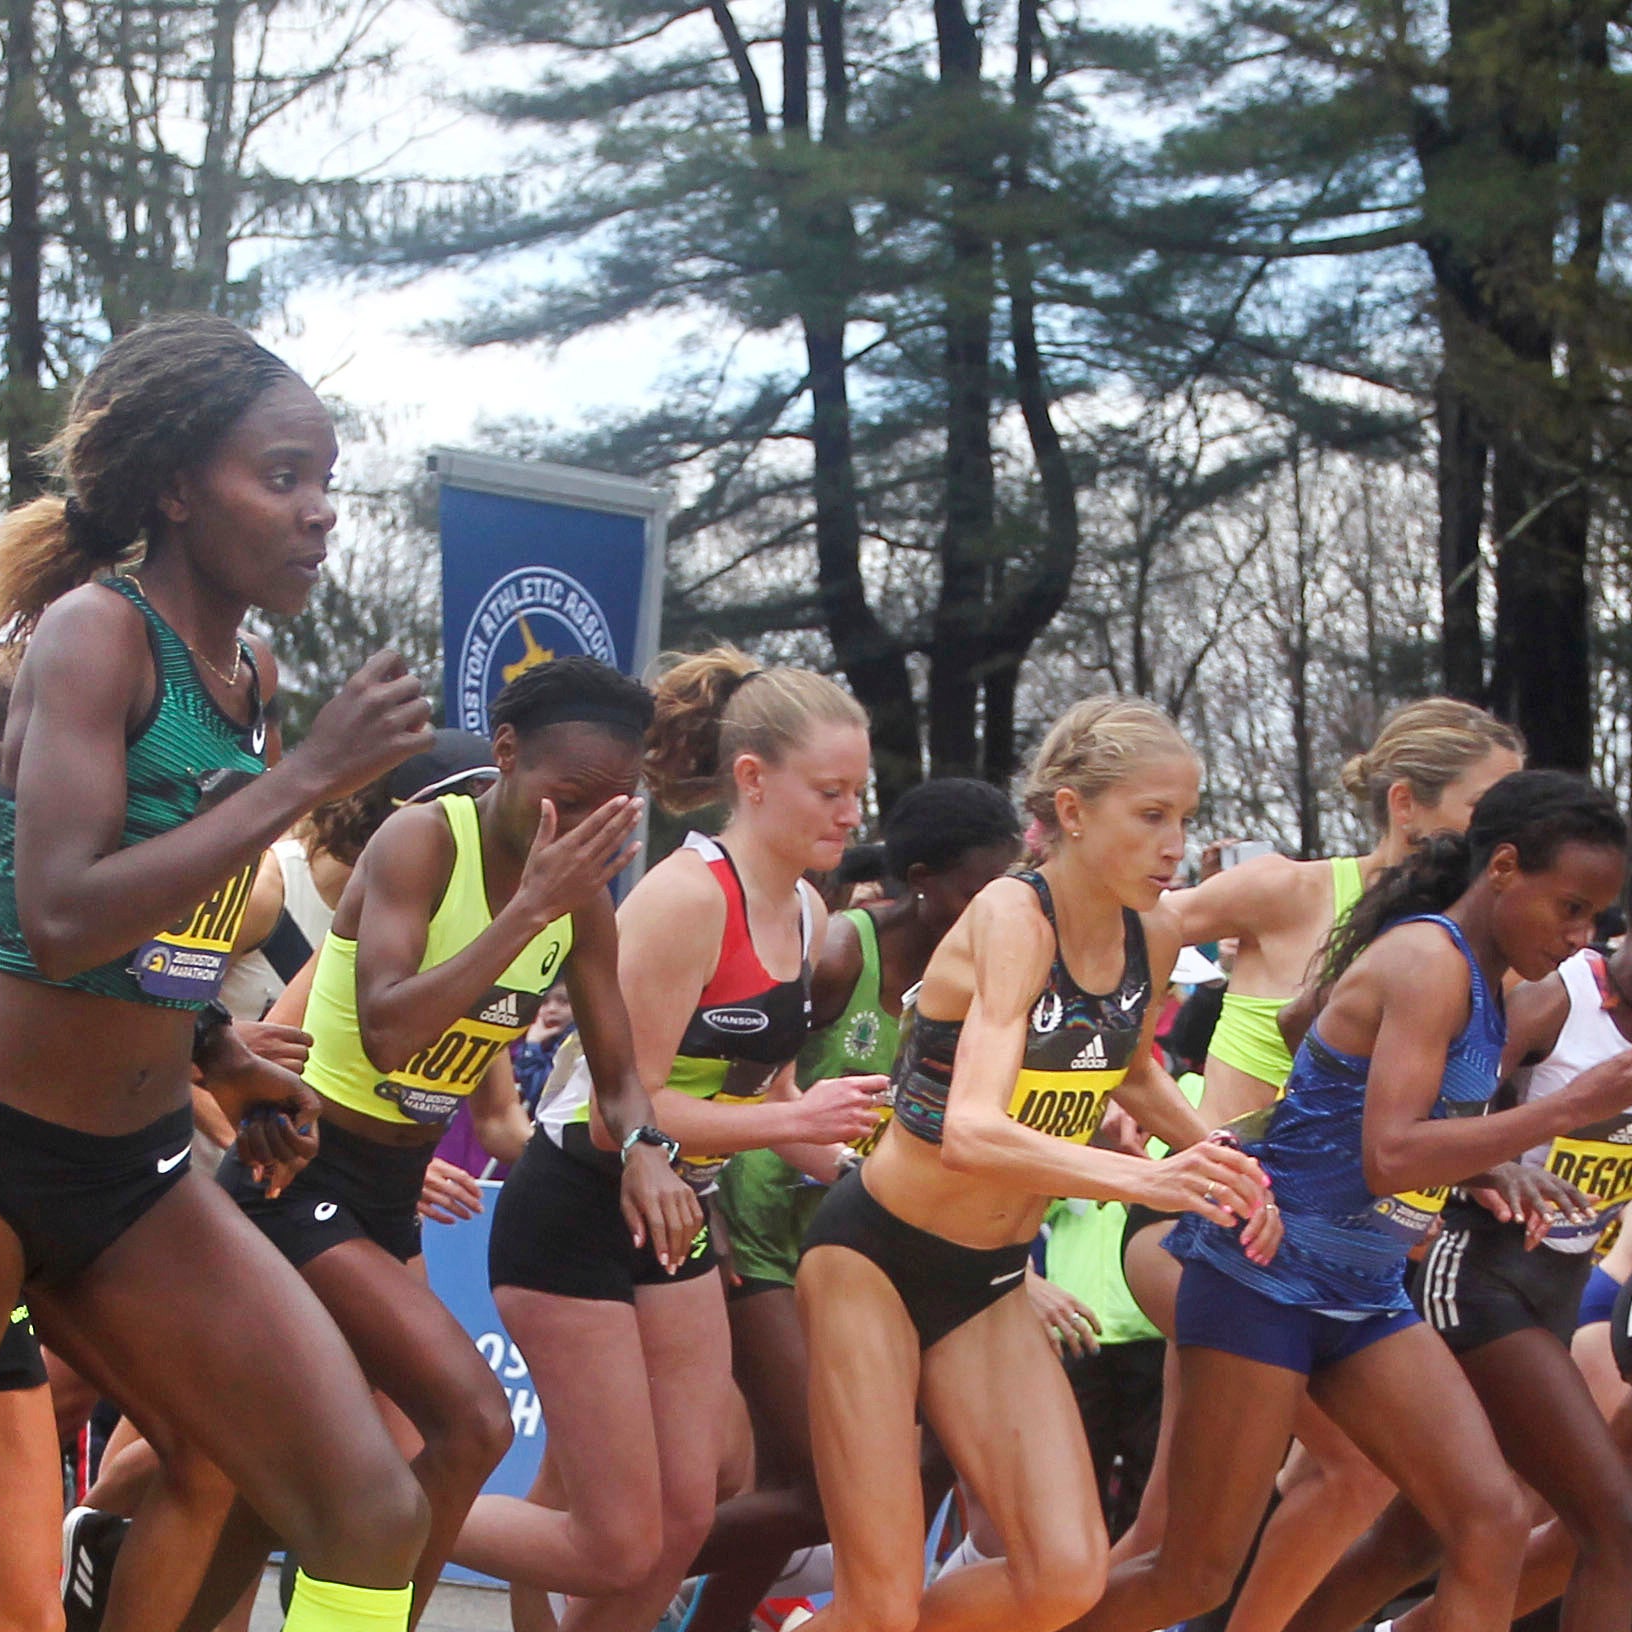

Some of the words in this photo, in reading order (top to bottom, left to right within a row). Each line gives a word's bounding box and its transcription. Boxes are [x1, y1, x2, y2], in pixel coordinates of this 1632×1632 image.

[464, 634, 489, 733] OSTON
[479, 575, 566, 638] ATHLETIC
[479, 1009, 520, 1027] adidas
[1070, 1057, 1109, 1069] adidas
